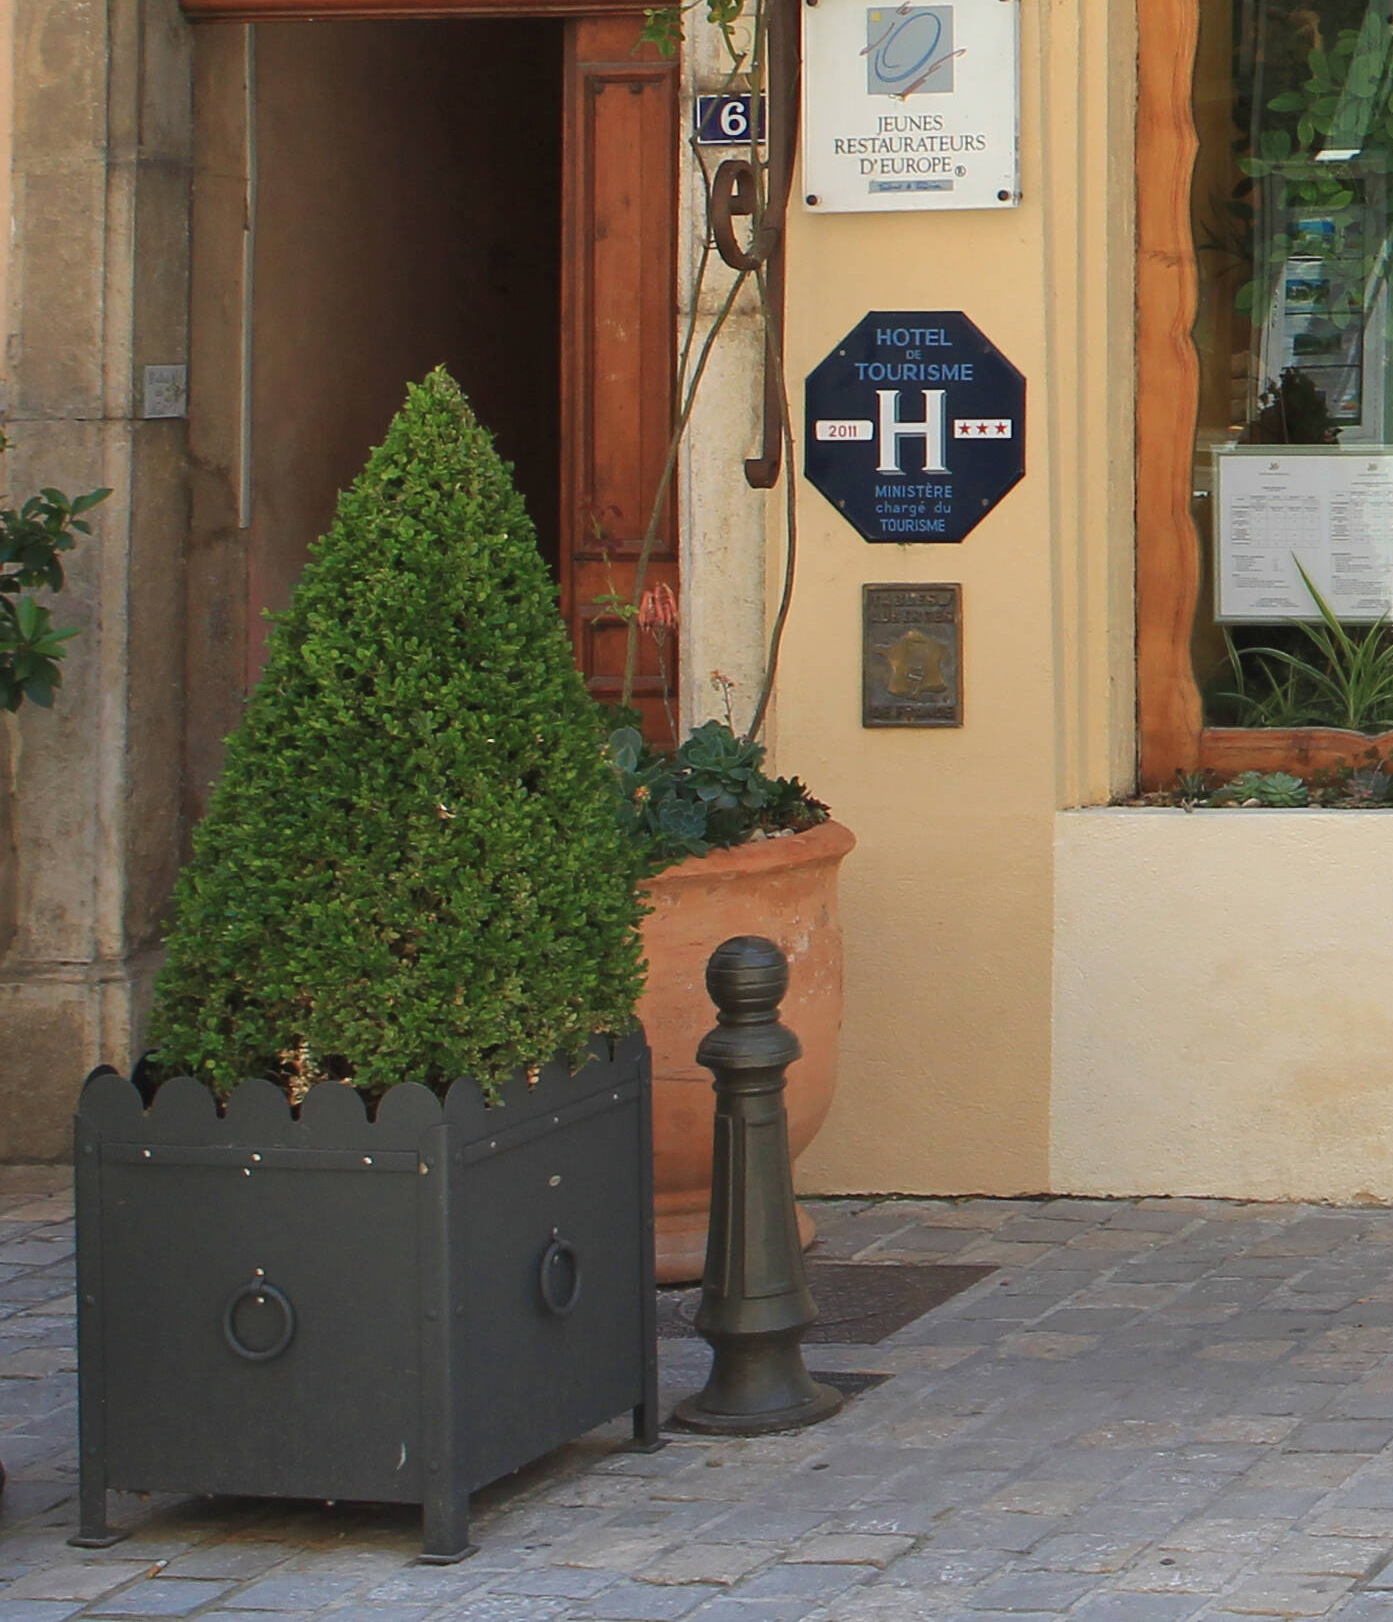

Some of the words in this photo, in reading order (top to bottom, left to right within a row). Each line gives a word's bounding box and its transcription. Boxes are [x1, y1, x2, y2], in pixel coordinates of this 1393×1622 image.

[720, 101, 748, 136] 6
[876, 115, 944, 135] JEUNES
[834, 135, 986, 155] RESTAURATEURS
[876, 328, 952, 346] HOTEL
[906, 350, 922, 360] DE
[855, 362, 973, 381] TOURISME
[828, 424, 858, 439] 2011
[876, 389, 952, 475] H
[875, 482, 953, 499] MINISTÈRE
[876, 501, 926, 516] chargé
[934, 500, 952, 514] du
[880, 518, 946, 533] TOURISME
